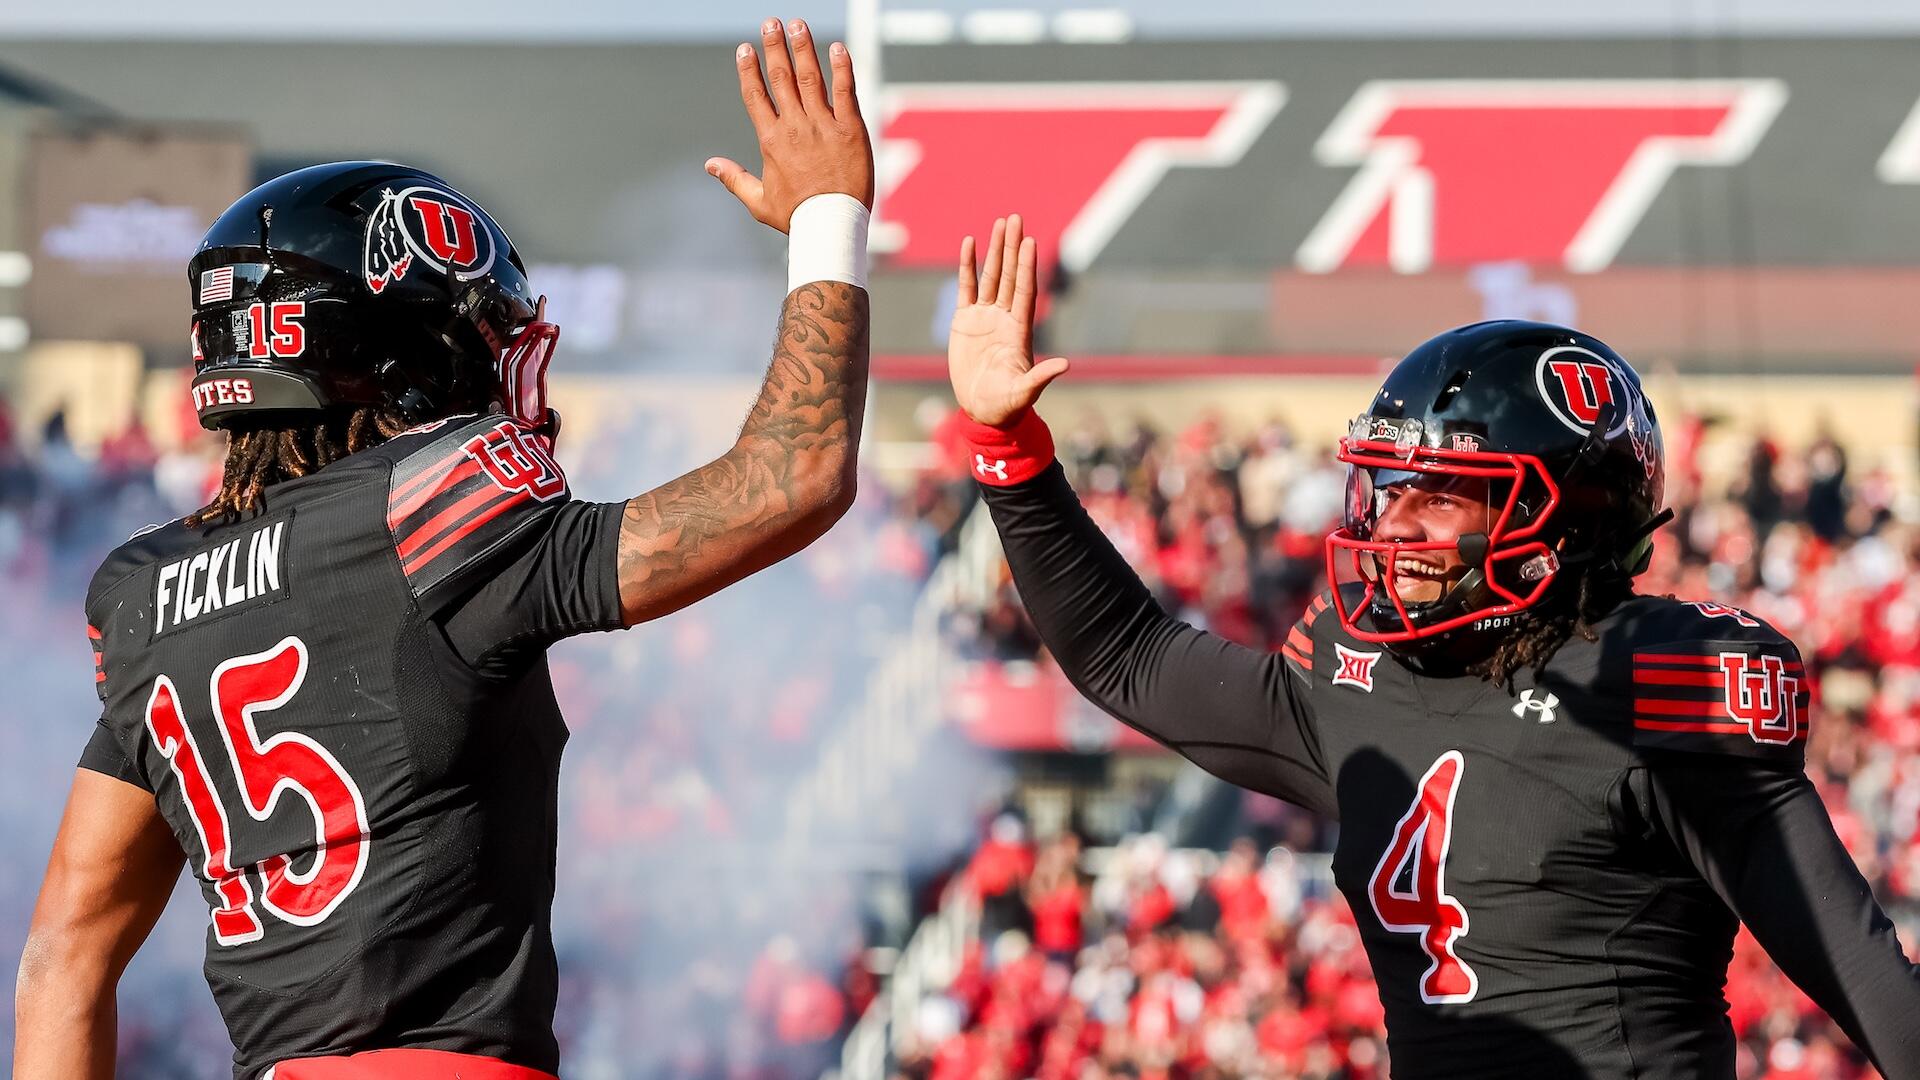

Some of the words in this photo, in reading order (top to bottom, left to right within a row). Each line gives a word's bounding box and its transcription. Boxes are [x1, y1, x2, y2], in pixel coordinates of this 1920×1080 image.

[412, 195, 478, 266] U
[248, 301, 305, 358] 15
[155, 521, 285, 635] FICKLIN
[145, 635, 370, 947] 15
[1368, 750, 1478, 1004] 4
